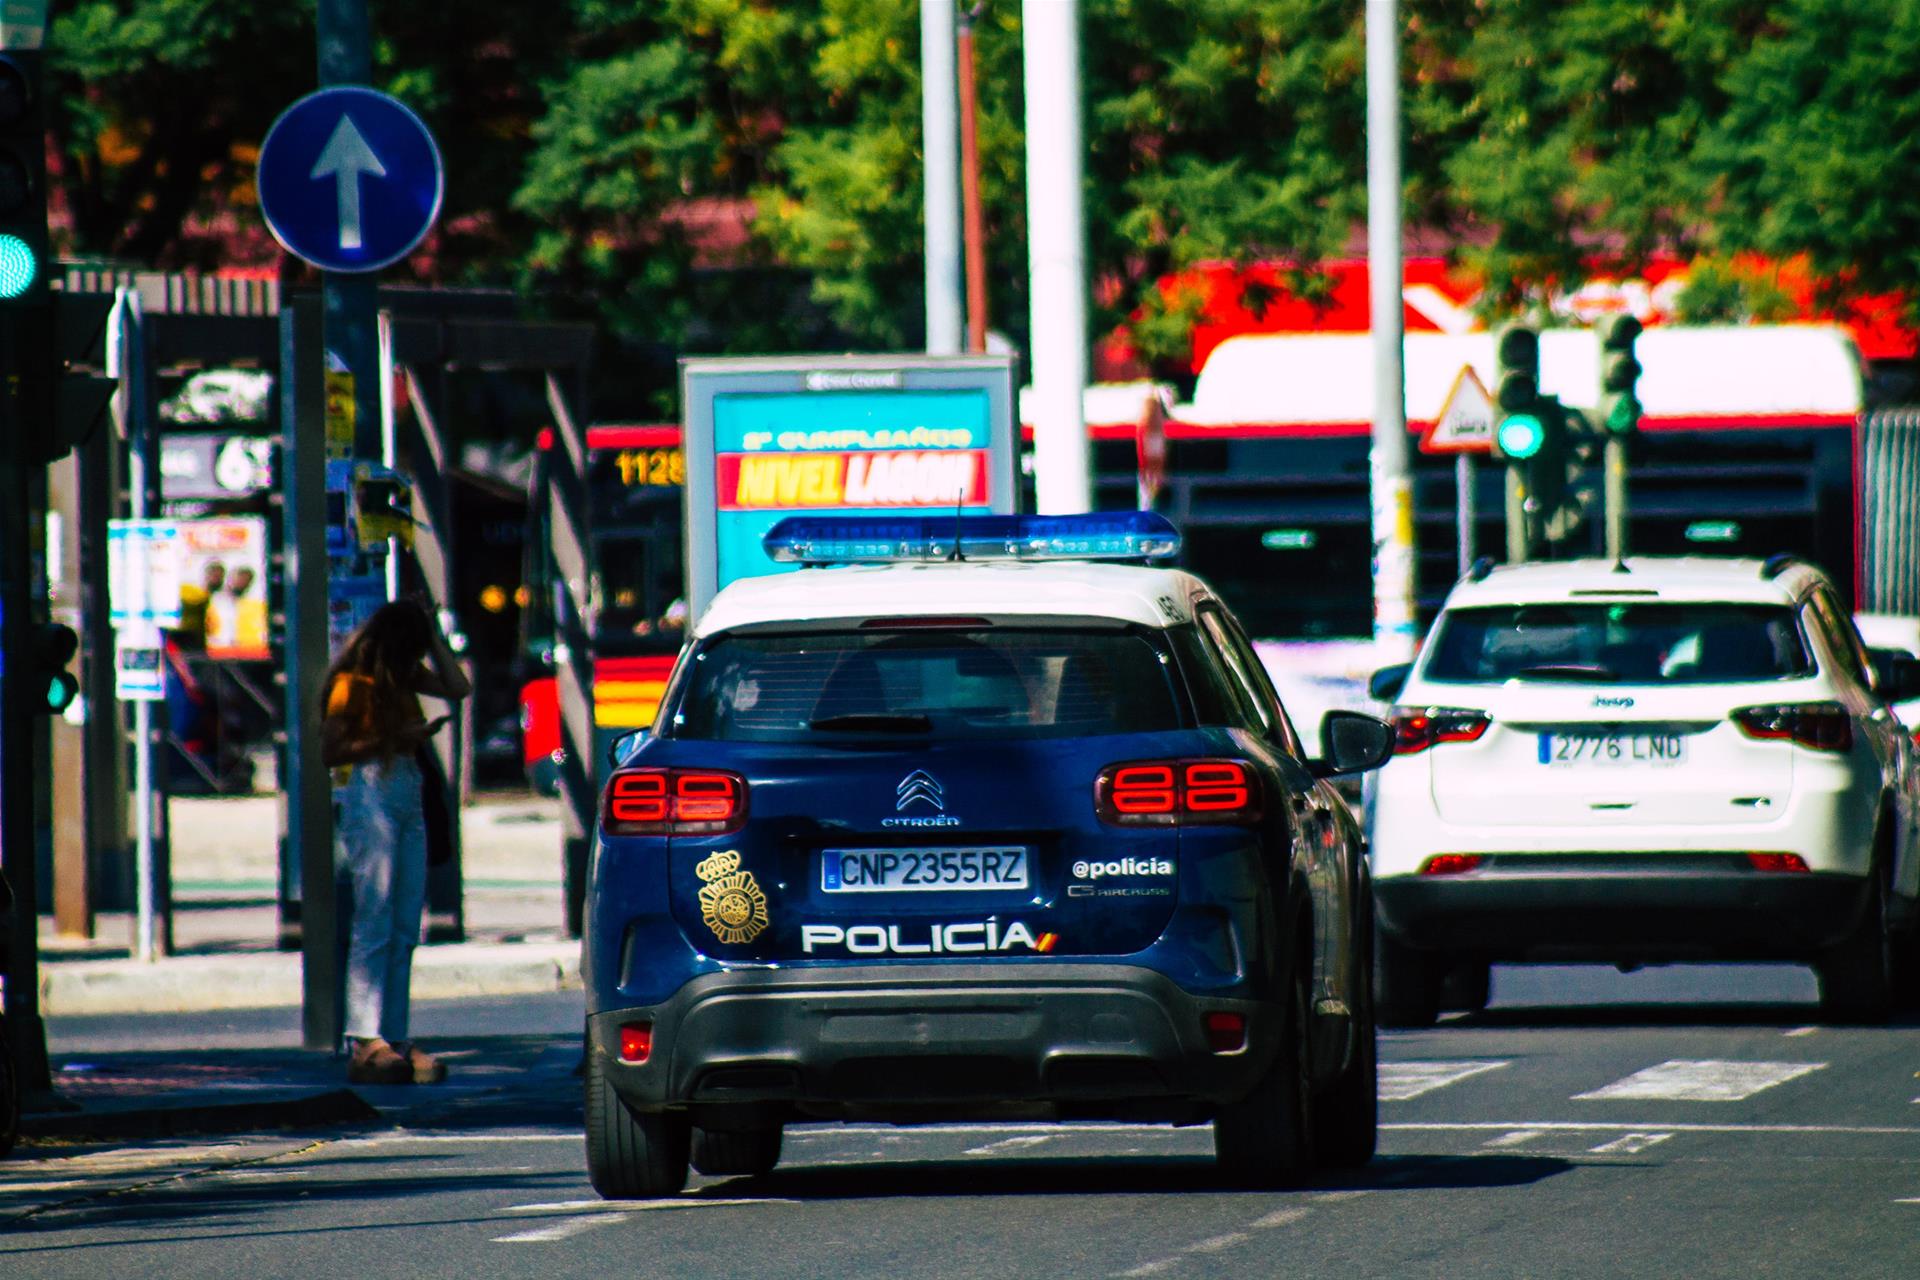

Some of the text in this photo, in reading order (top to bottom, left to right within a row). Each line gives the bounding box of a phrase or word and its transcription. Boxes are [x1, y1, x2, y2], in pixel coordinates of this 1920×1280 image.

[737, 454, 842, 505] NIVEL
[1556, 736, 1681, 760] 2776 LND
[841, 852, 1021, 885] CNP2355RZ
[1072, 857, 1173, 879] @policia
[801, 915, 1036, 953] POLICÍA
